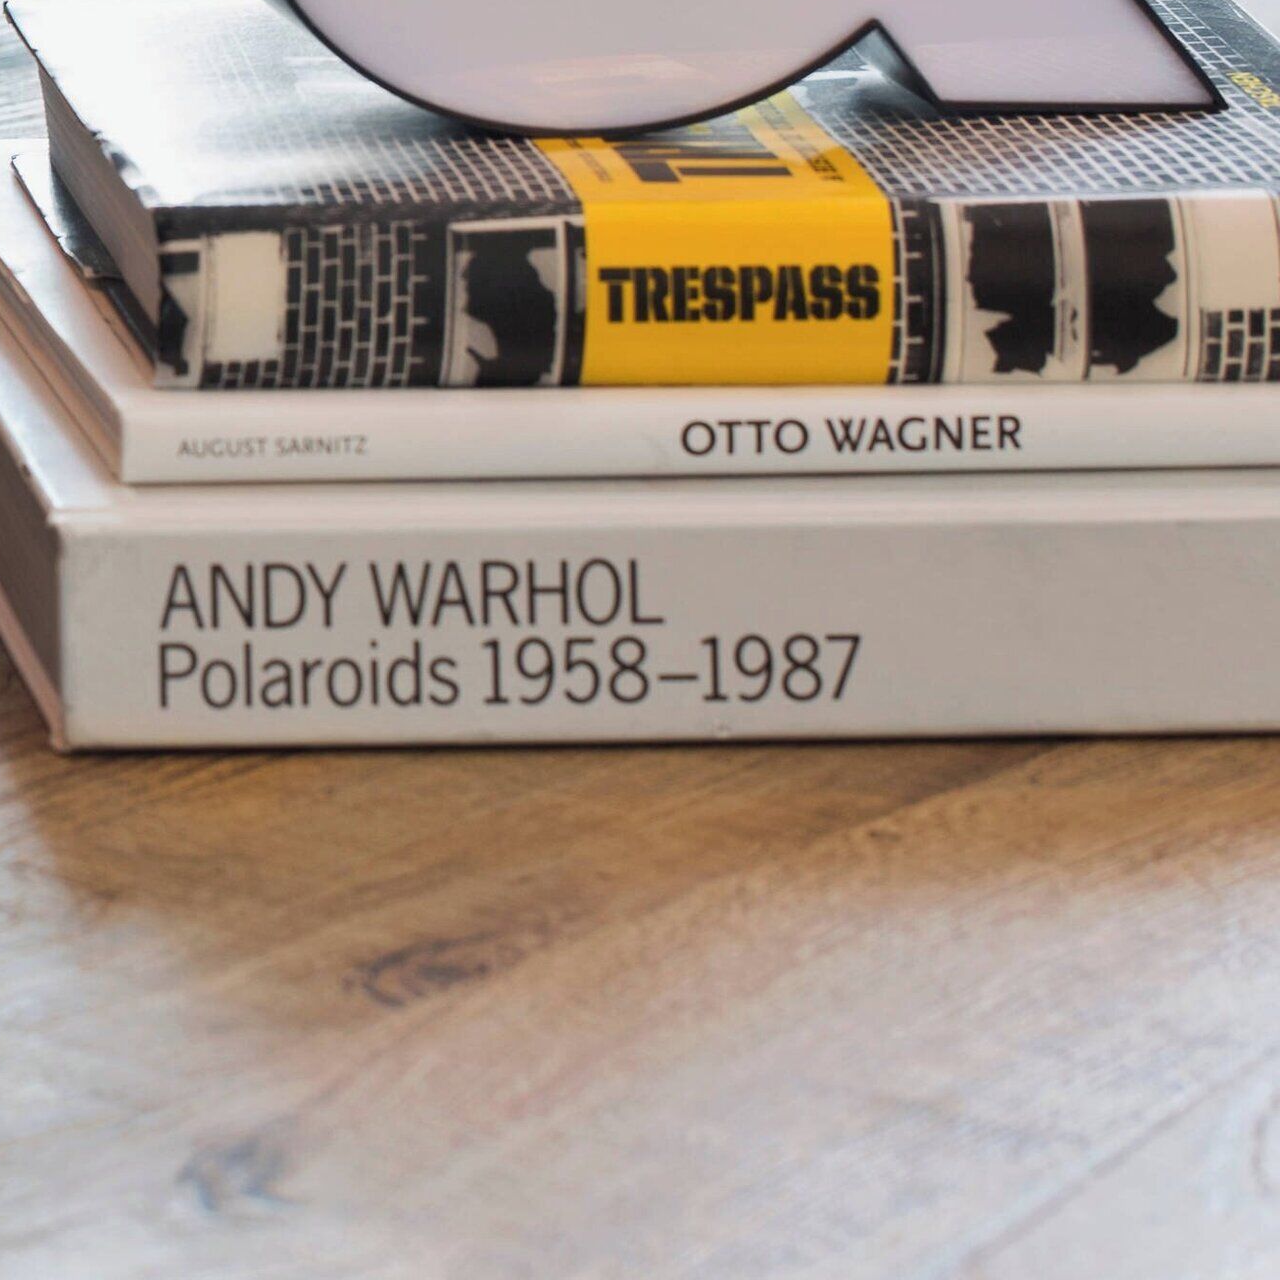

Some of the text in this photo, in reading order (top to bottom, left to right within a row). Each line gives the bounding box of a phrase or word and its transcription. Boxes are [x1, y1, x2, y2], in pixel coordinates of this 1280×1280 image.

[597, 263, 881, 324] TRESPASS
[176, 433, 369, 459] AUGUST SARNITZ
[680, 415, 1023, 456] OTTO WAGNER
[158, 557, 666, 629] ANDY WARHOL
[158, 639, 461, 709] Polaroids
